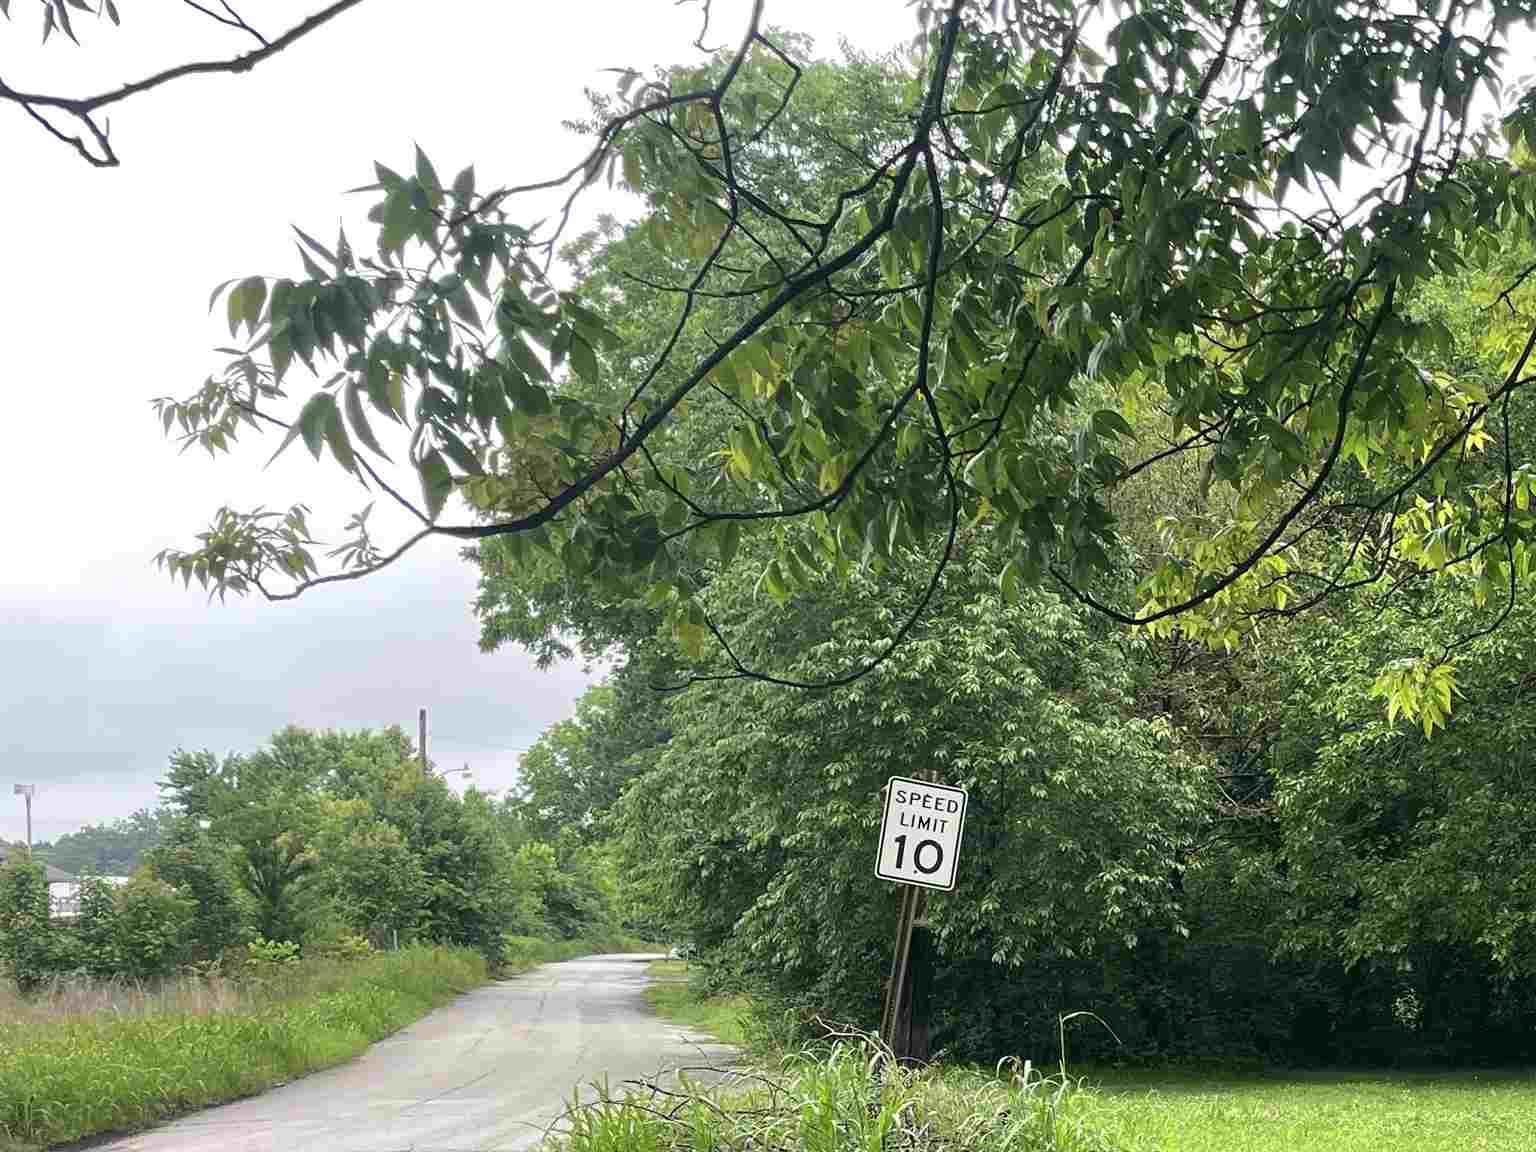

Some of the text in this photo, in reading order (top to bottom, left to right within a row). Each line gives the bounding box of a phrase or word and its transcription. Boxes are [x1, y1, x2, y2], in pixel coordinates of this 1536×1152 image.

[895, 790, 958, 813] SPEED
[900, 812, 948, 833] LIMIT
[894, 834, 944, 874] 10
